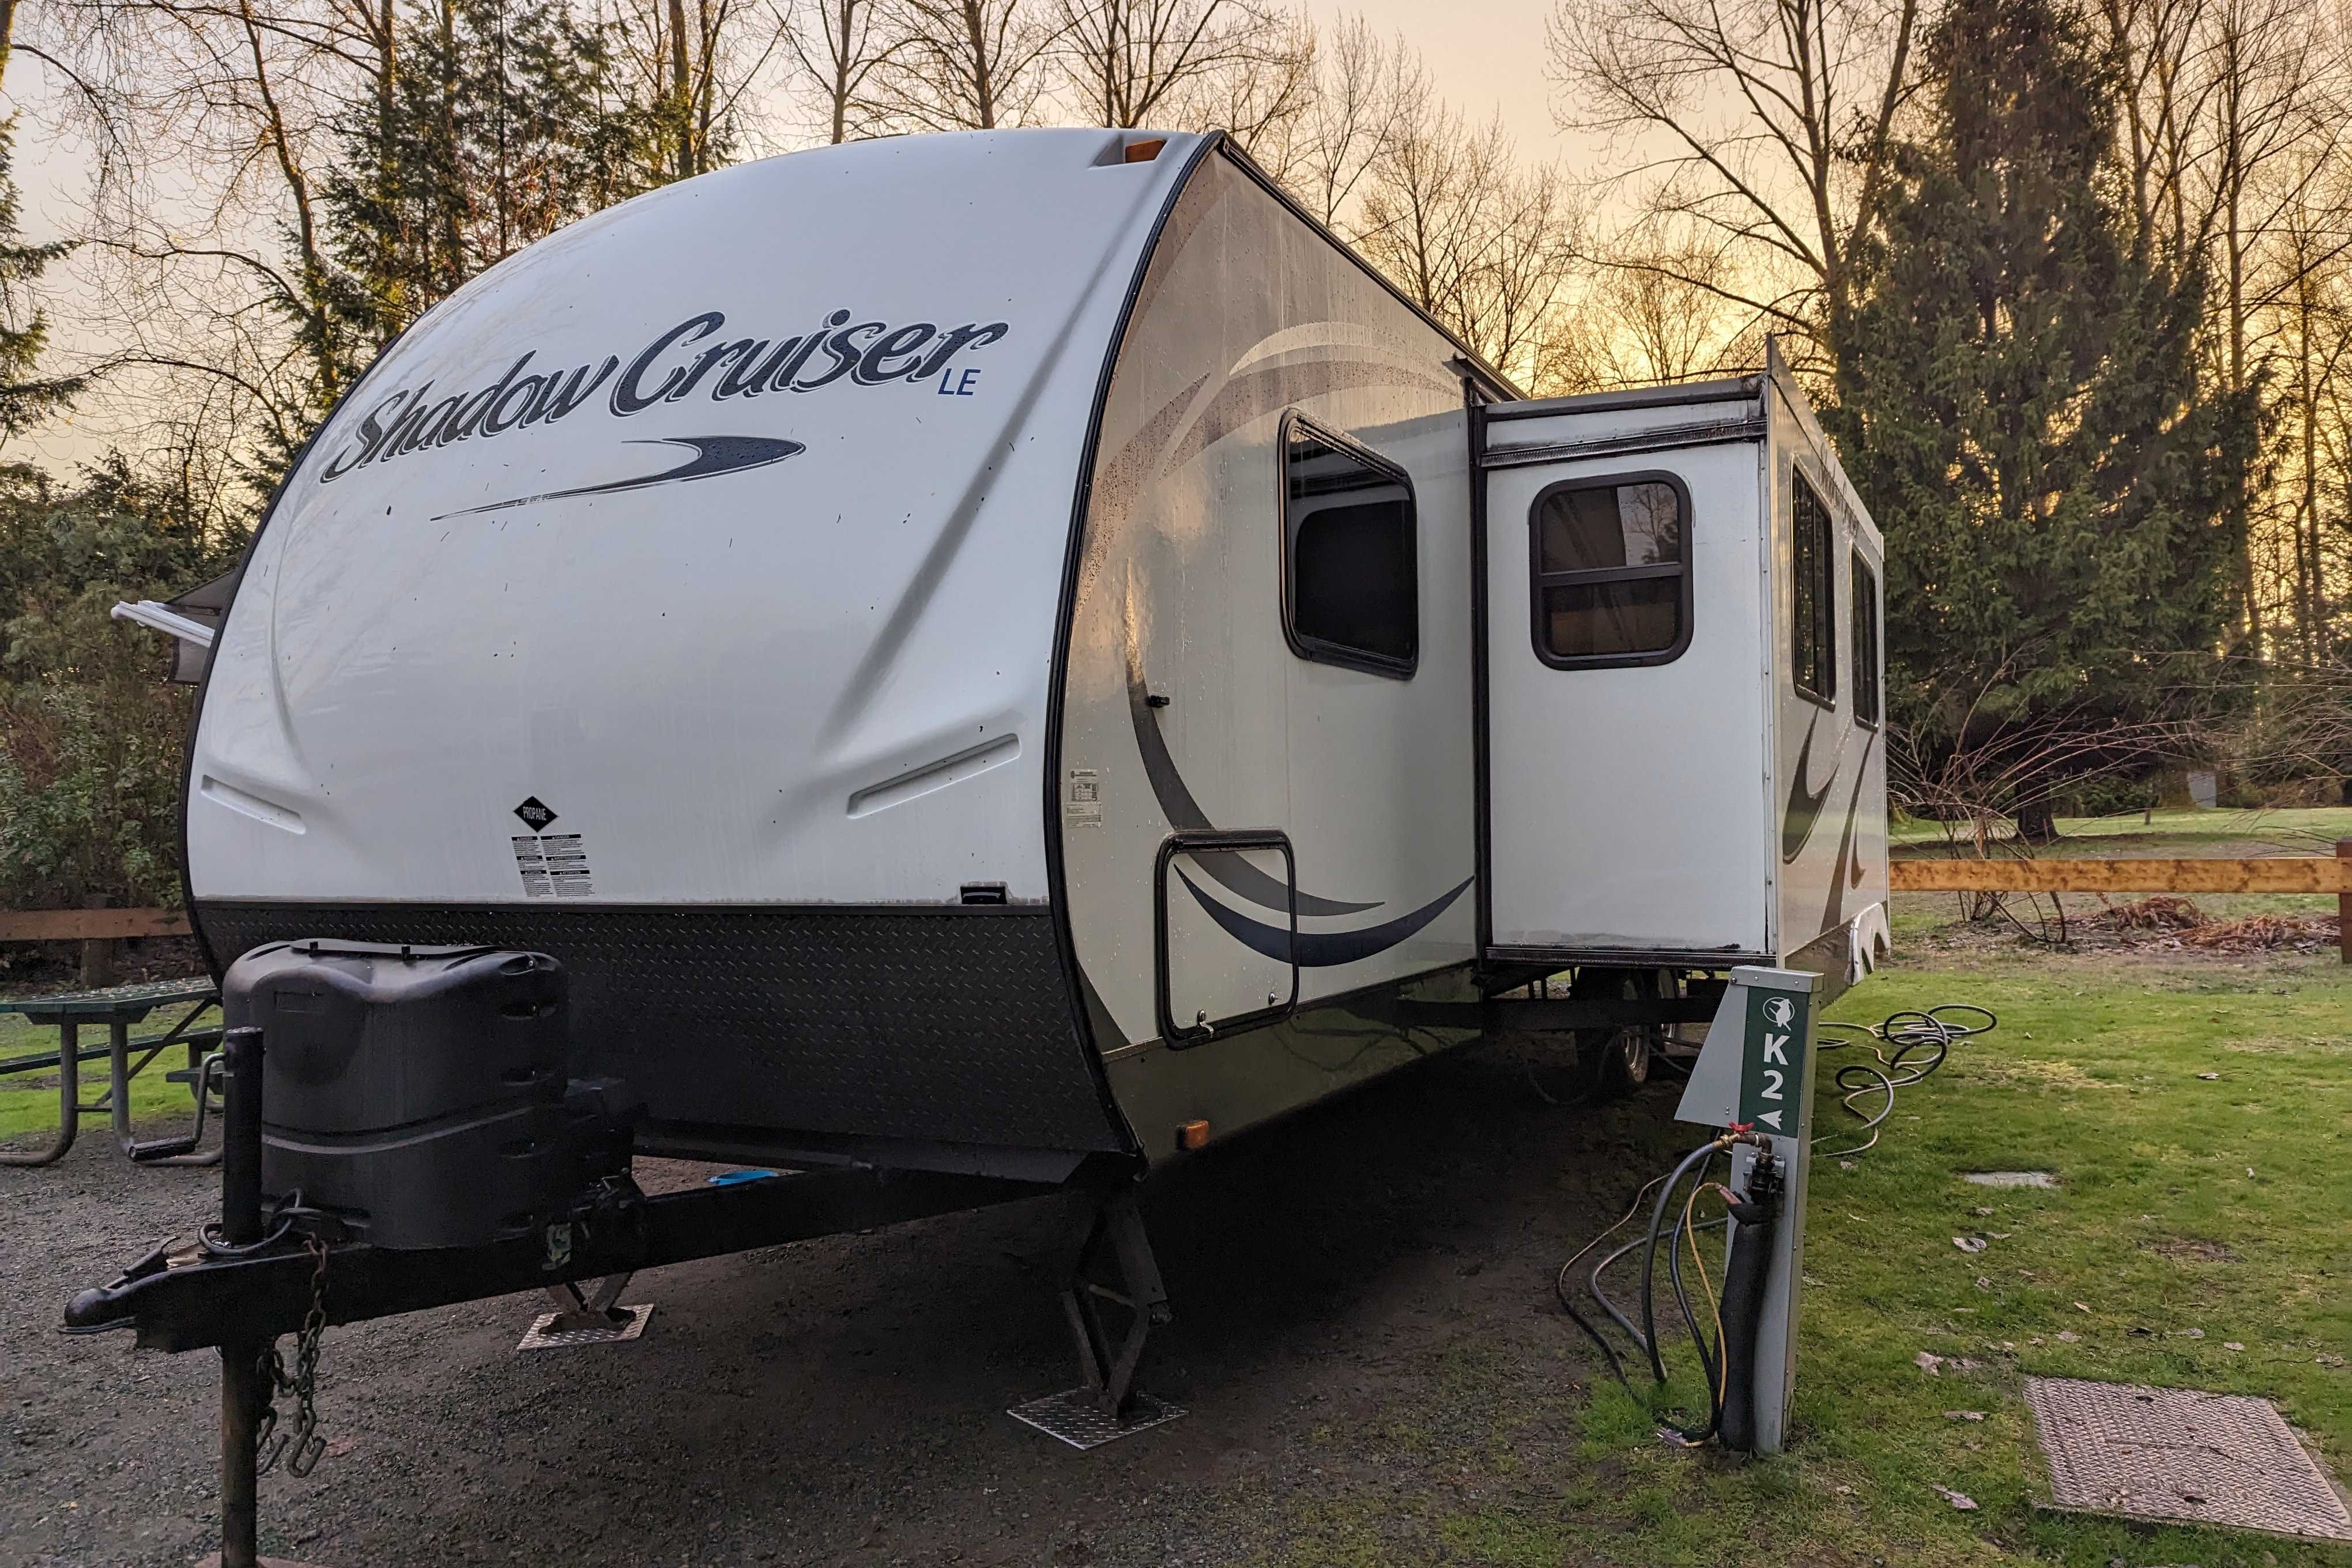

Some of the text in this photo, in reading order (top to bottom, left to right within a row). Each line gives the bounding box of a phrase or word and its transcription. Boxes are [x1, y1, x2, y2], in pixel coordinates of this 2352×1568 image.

[320, 307, 1010, 484] Shadow Cruiser
[938, 368, 982, 396] LE
[523, 806, 546, 821] PROPANE
